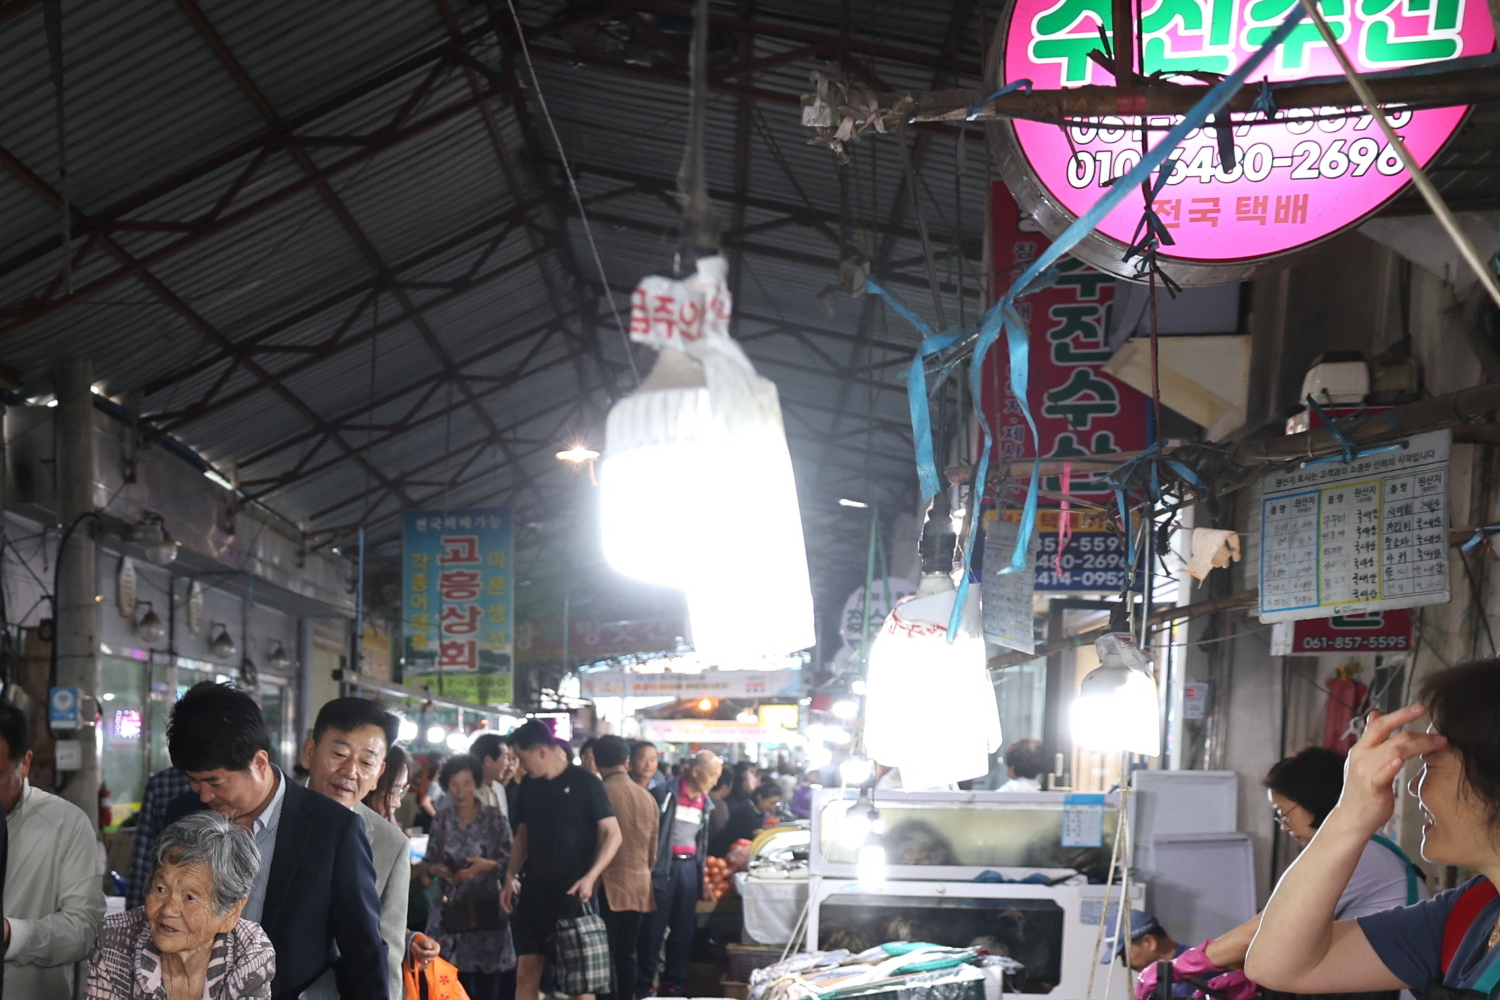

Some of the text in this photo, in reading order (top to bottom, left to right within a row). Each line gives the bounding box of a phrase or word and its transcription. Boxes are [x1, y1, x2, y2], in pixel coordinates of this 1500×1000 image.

[1151, 193, 1310, 229] 전국 택배
[1319, 466, 1348, 479] 고객과의
[1397, 450, 1436, 464] 시작입니다
[1418, 474, 1442, 487] 원산지
[1354, 485, 1377, 498] 원산지
[437, 534, 483, 671] 고흥상회
[1303, 636, 1407, 650] 061-857-5595
